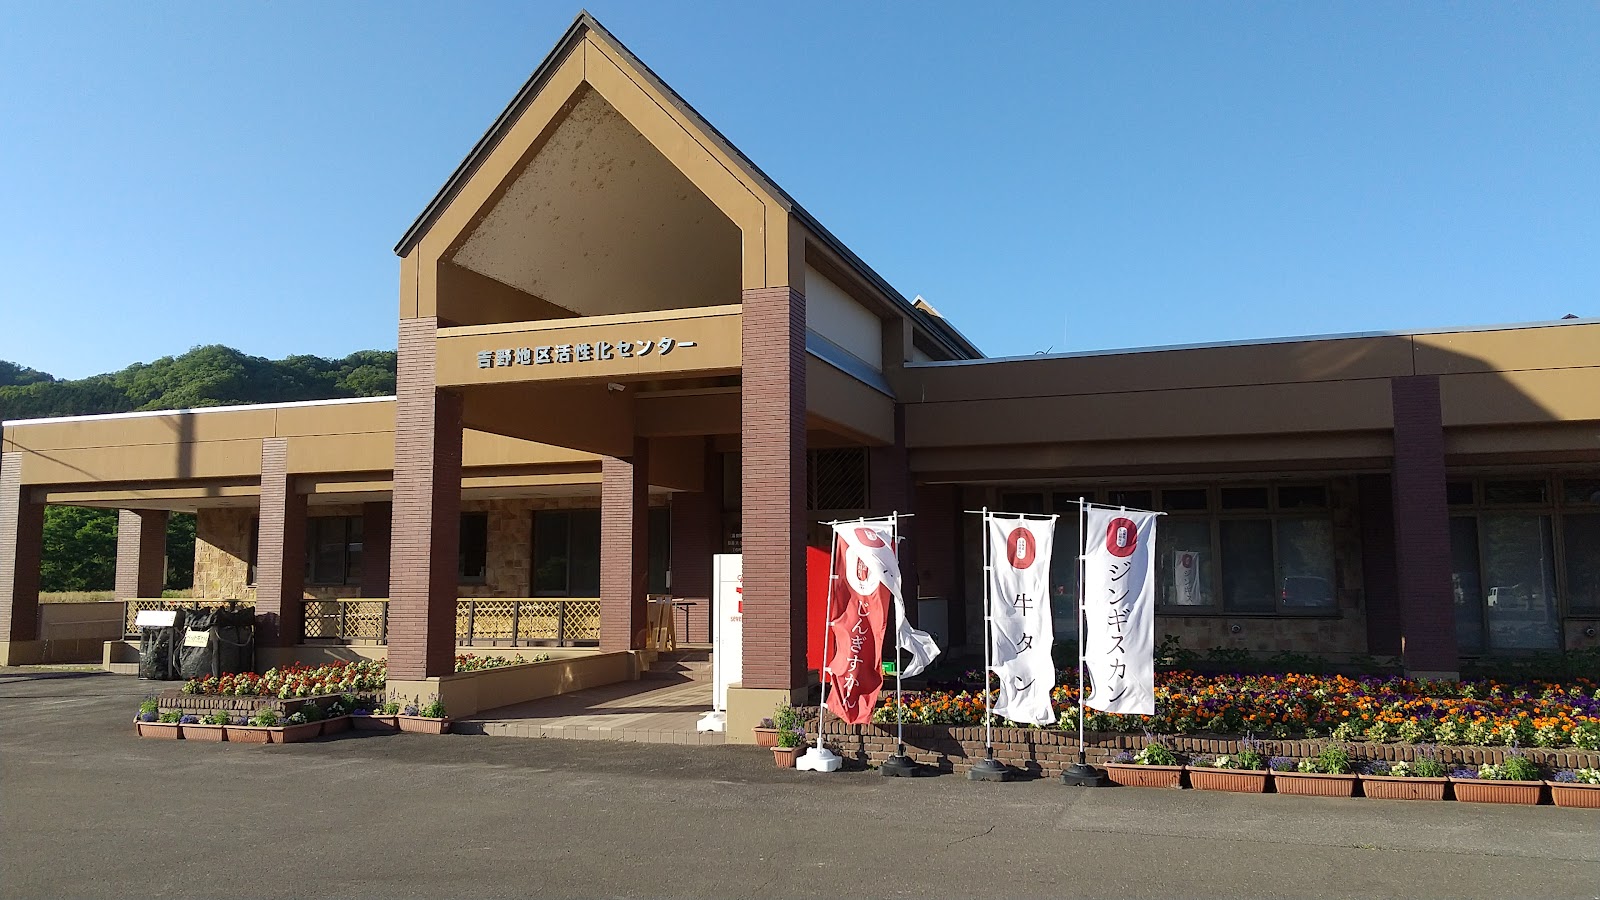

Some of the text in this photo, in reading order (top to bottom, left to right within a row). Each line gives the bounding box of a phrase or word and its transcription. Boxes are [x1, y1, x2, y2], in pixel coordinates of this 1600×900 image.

[477, 336, 698, 369] 吉野地区活性化センター
[842, 600, 871, 711] じんぎすかん
[1012, 592, 1037, 692] 牛タン
[1106, 560, 1132, 703] ジンギスカン
